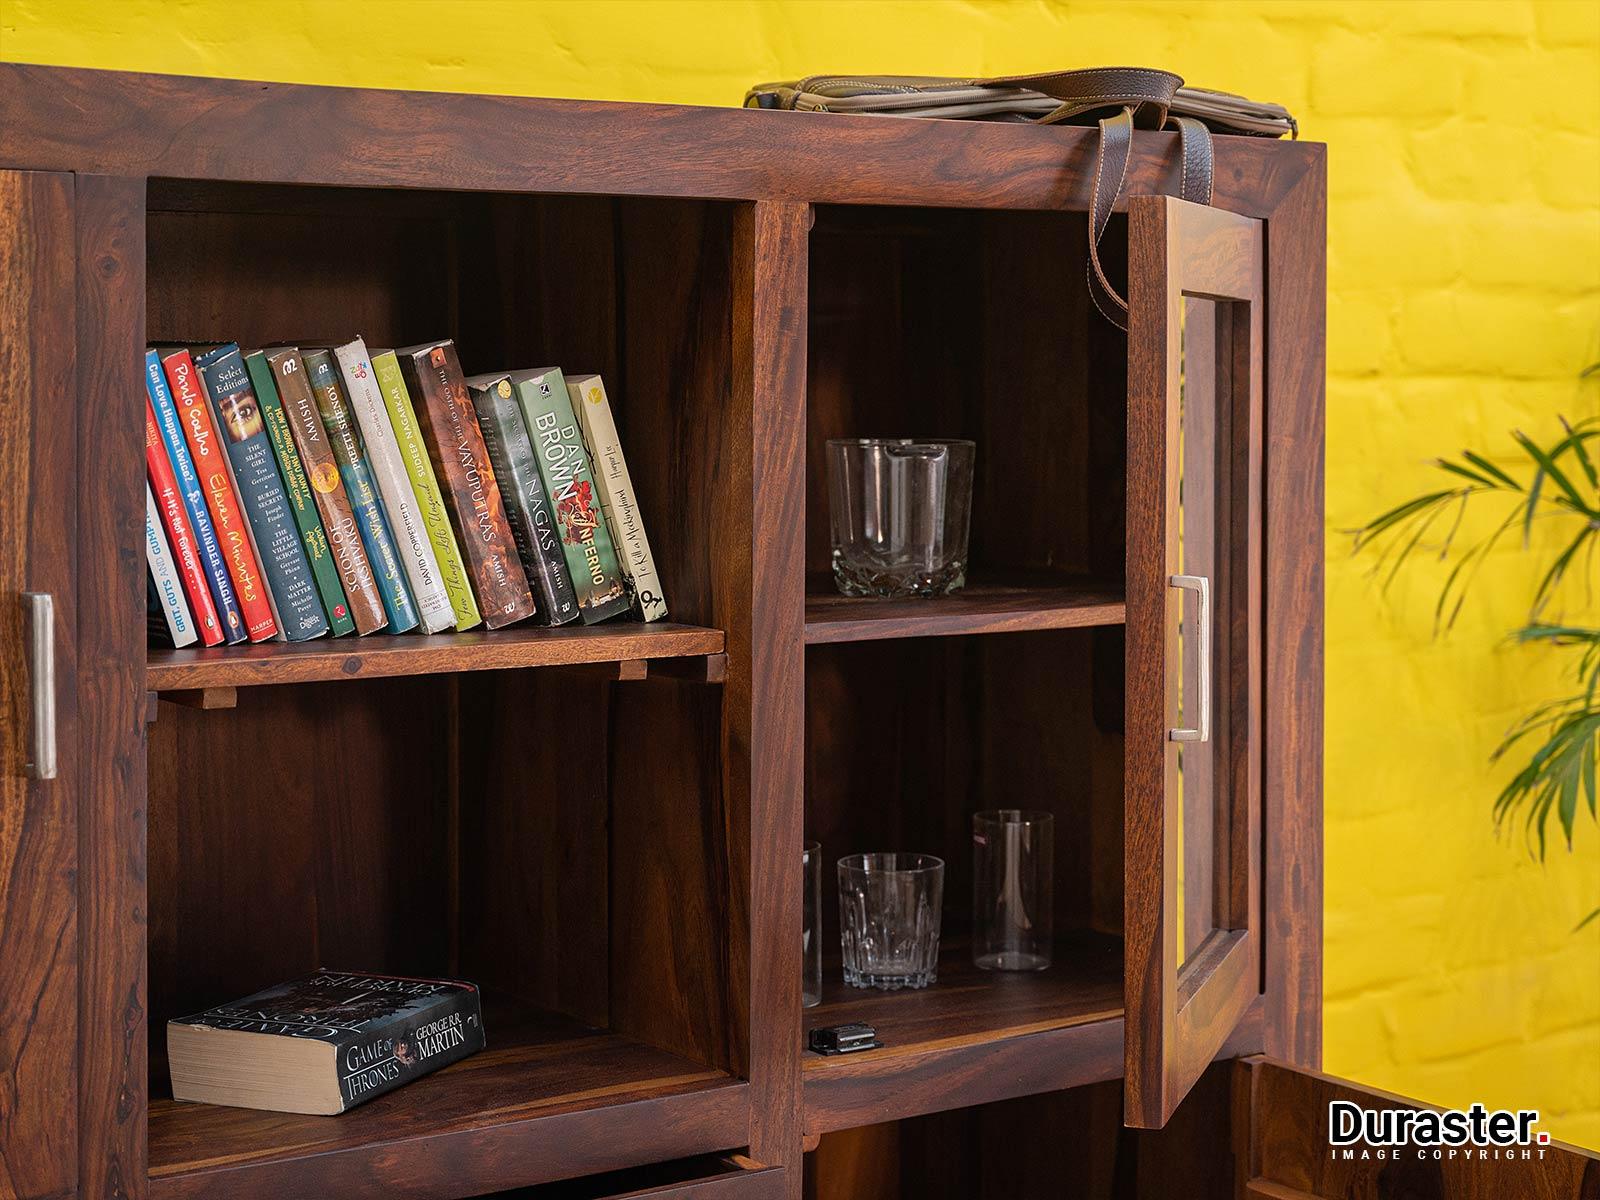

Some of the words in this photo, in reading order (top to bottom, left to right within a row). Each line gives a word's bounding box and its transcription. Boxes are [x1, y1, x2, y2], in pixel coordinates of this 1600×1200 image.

[216, 376, 248, 394] Editions
[218, 366, 242, 382] Select
[149, 364, 160, 384] Can
[155, 384, 168, 409] Love
[163, 408, 180, 449] Happen
[176, 446, 194, 482] Twice?
[175, 363, 197, 406] Paulo
[190, 408, 210, 456] Coelho
[298, 398, 320, 442] AMISH
[326, 386, 347, 430] SHENOY
[392, 387, 414, 440] NAGARKAR
[246, 449, 266, 462] SILENT
[247, 444, 261, 452] THE
[251, 458, 266, 468] GIRL
[274, 408, 285, 423] HOW
[290, 454, 301, 472] ANU
[297, 473, 310, 500] AUNTY
[341, 429, 361, 470] PREETI
[408, 444, 426, 477] SUDEEP
[438, 369, 447, 384] THE
[444, 387, 455, 410] OATH
[458, 441, 496, 542] VAYUPUTRAS
[536, 412, 578, 500] BROWN
[560, 426, 586, 475] DAN
[257, 488, 280, 501] BURIED
[258, 494, 283, 508] SECRETS
[360, 482, 374, 506] List
[163, 487, 174, 498] If
[172, 516, 186, 534] Not
[366, 507, 384, 539] Wish
[526, 479, 555, 550] NAGAS
[614, 488, 641, 542] Mockingbird
[209, 474, 230, 529] Eleven
[227, 531, 257, 602] Minutes
[272, 535, 294, 547] LITTLE
[274, 529, 288, 538] THE
[329, 525, 344, 545] OF
[400, 502, 424, 558] COPPERFIELD
[196, 510, 220, 568] RAVINDER
[215, 568, 233, 605] SINGH
[272, 541, 298, 555] VILLAGE
[275, 548, 300, 561] SCHOOL
[342, 517, 372, 588] IKSHVAKU
[632, 550, 648, 566] Kill
[156, 557, 168, 577] AND
[338, 548, 360, 593] SCION
[418, 558, 432, 586] DAVID
[446, 559, 464, 597] Things
[491, 554, 507, 587] AMISH
[550, 561, 563, 589] AMISH
[163, 579, 177, 606] GUTS
[288, 580, 306, 592] DARK
[288, 586, 312, 600] MATTER
[394, 586, 406, 610] The
[172, 606, 186, 633] GRIT,
[250, 618, 273, 633] HARPER
[416, 1018, 448, 1040] GEORGE
[418, 1024, 465, 1060] MARTIN
[346, 1039, 383, 1072] GAME
[384, 1038, 393, 1052] OF
[344, 1059, 399, 1101] THRONES
